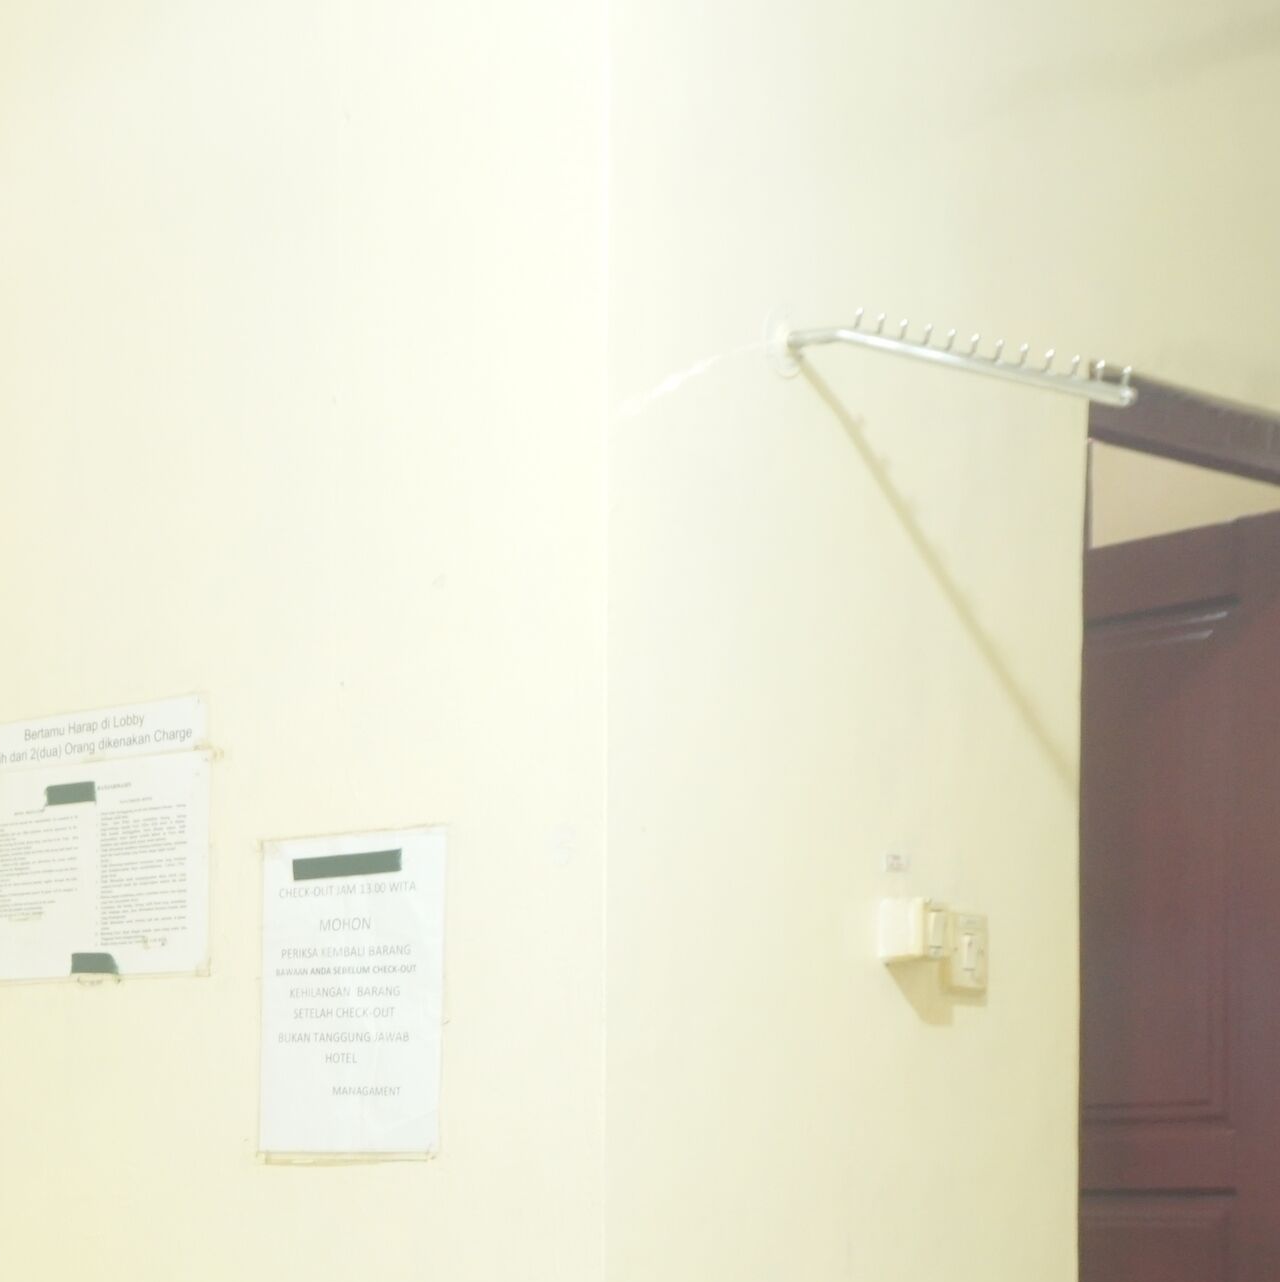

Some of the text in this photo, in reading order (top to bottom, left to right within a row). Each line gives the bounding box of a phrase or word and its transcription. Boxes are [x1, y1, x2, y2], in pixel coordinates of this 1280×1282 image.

[24, 714, 145, 741] Bertamu Harap di Lobby
[30, 745, 62, 761] 2(dua)
[64, 741, 95, 755] Orang
[98, 733, 151, 750] dikenakan
[153, 727, 193, 741] Charge
[279, 881, 416, 898] CHECK-OUT JAM 13.00 WITA
[319, 917, 371, 932] MOHON
[281, 945, 412, 959] PERIKSA KEMBALI BARANG
[276, 964, 416, 976] BAWAAN ANDA SEBELUM CHECK-OUT
[289, 985, 400, 998] KEHILANGAN BARANG
[293, 1007, 395, 1019] SETELAH CHECK-OUT
[278, 1031, 409, 1043] BUKAN TANGGUNG JAWAB
[325, 1052, 358, 1064] HOTEL
[332, 1086, 401, 1096] MANAGAMENT
